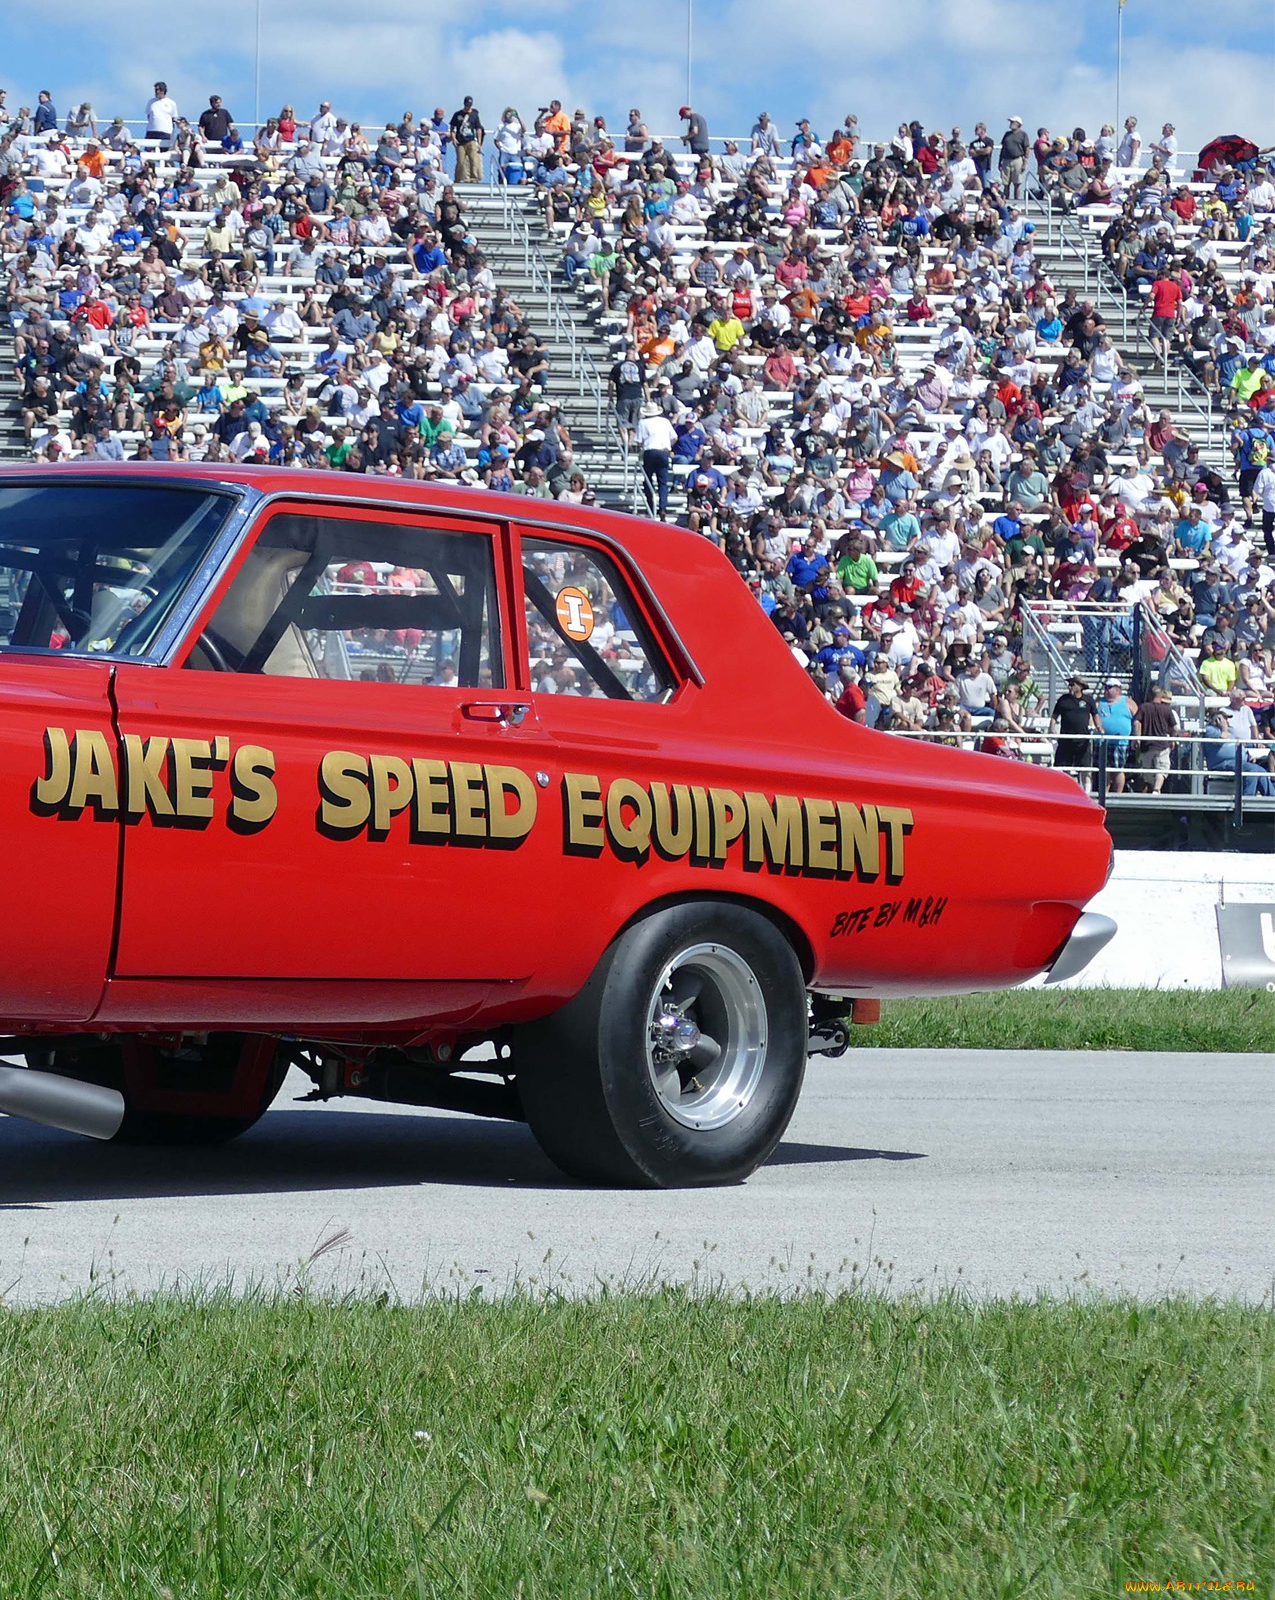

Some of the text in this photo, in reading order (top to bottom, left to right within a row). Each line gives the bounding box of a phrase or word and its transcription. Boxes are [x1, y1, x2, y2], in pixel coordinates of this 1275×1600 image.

[27, 726, 914, 886] JAKE'S SPEED EQUIPMENT
[829, 895, 949, 938] BITE BY M&H
